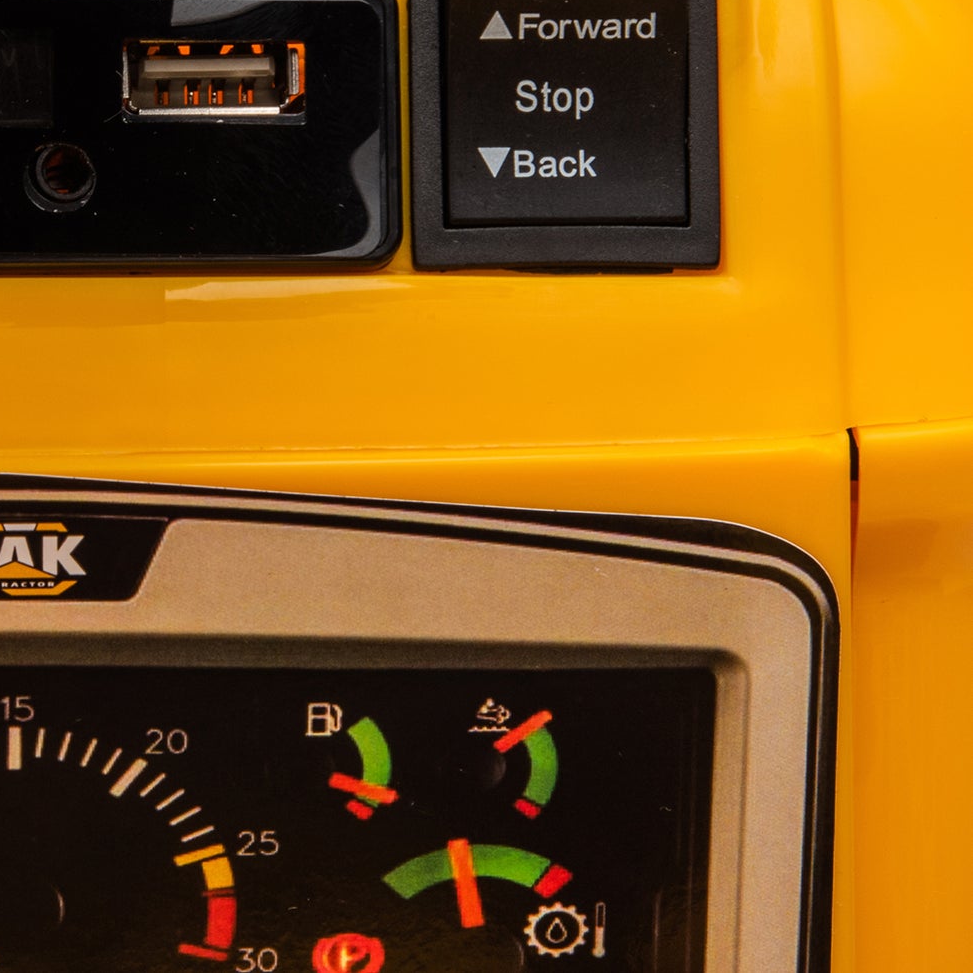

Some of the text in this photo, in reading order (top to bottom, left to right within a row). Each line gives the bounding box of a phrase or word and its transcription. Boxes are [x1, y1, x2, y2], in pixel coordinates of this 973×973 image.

[517, 12, 657, 41] Forward
[515, 80, 595, 120] Stop
[513, 149, 597, 178] Back
[0, 696, 35, 721] 15
[145, 729, 188, 755] 20
[237, 831, 280, 856] 25
[235, 948, 278, 973] 30
